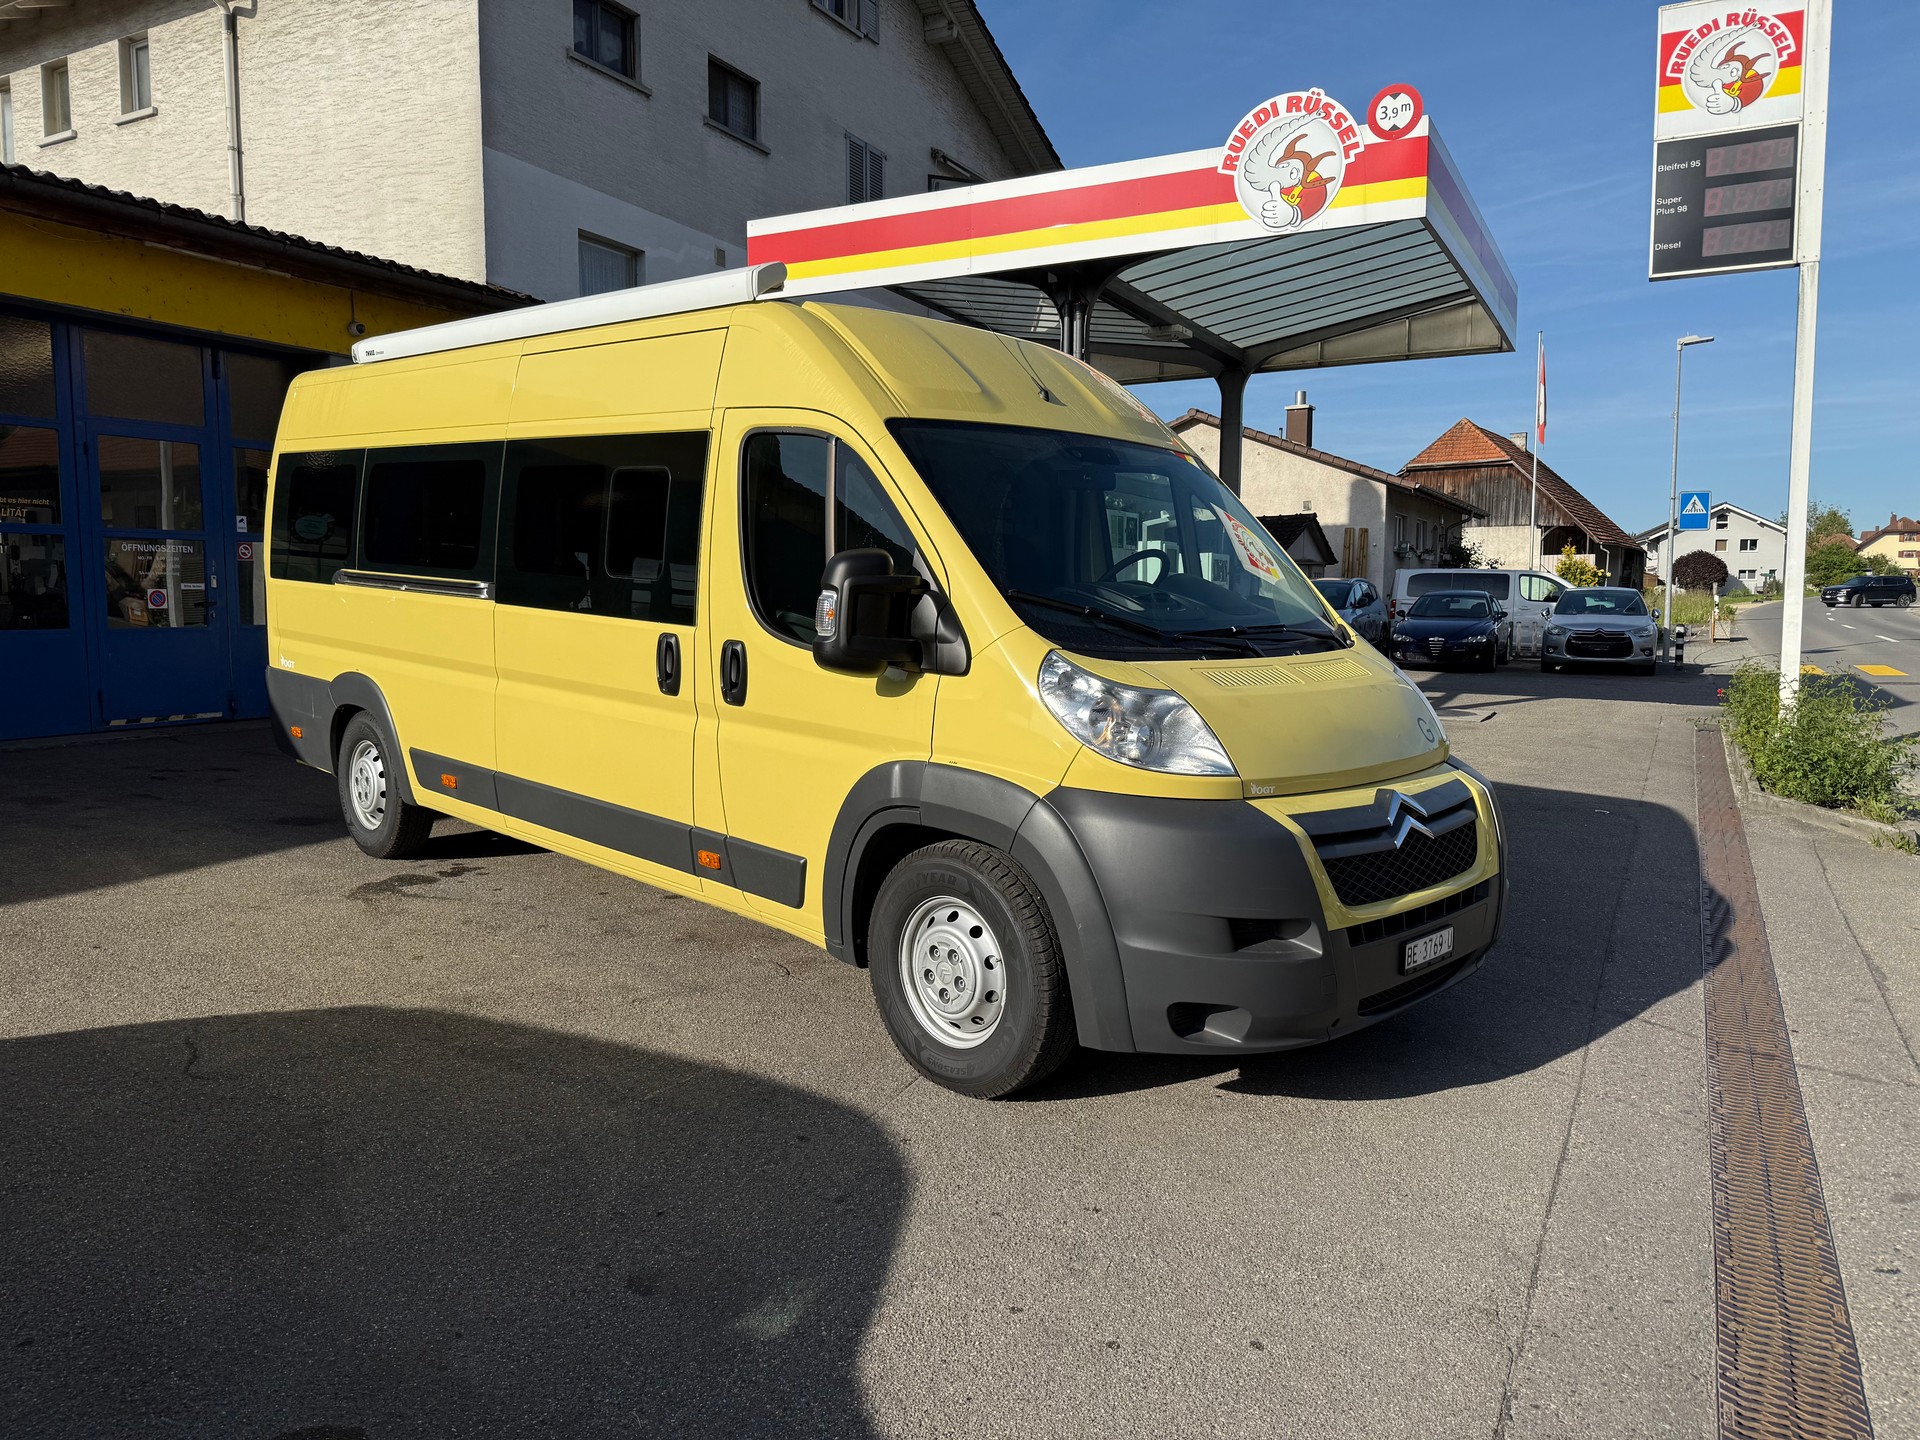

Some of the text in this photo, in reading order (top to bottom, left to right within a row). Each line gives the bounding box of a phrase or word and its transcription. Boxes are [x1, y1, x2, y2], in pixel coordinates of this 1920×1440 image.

[1669, 8, 1792, 74] RUEDI RÜSSEL
[1221, 90, 1361, 171] RUEDI RÜSSEL
[1657, 159, 1701, 173] Bleifrei 95
[1656, 196, 1683, 206] Super
[1656, 205, 1688, 216] Plus 98
[1654, 241, 1681, 251] Diesel
[121, 541, 194, 553] ÖFFNUNGSZEITEN
